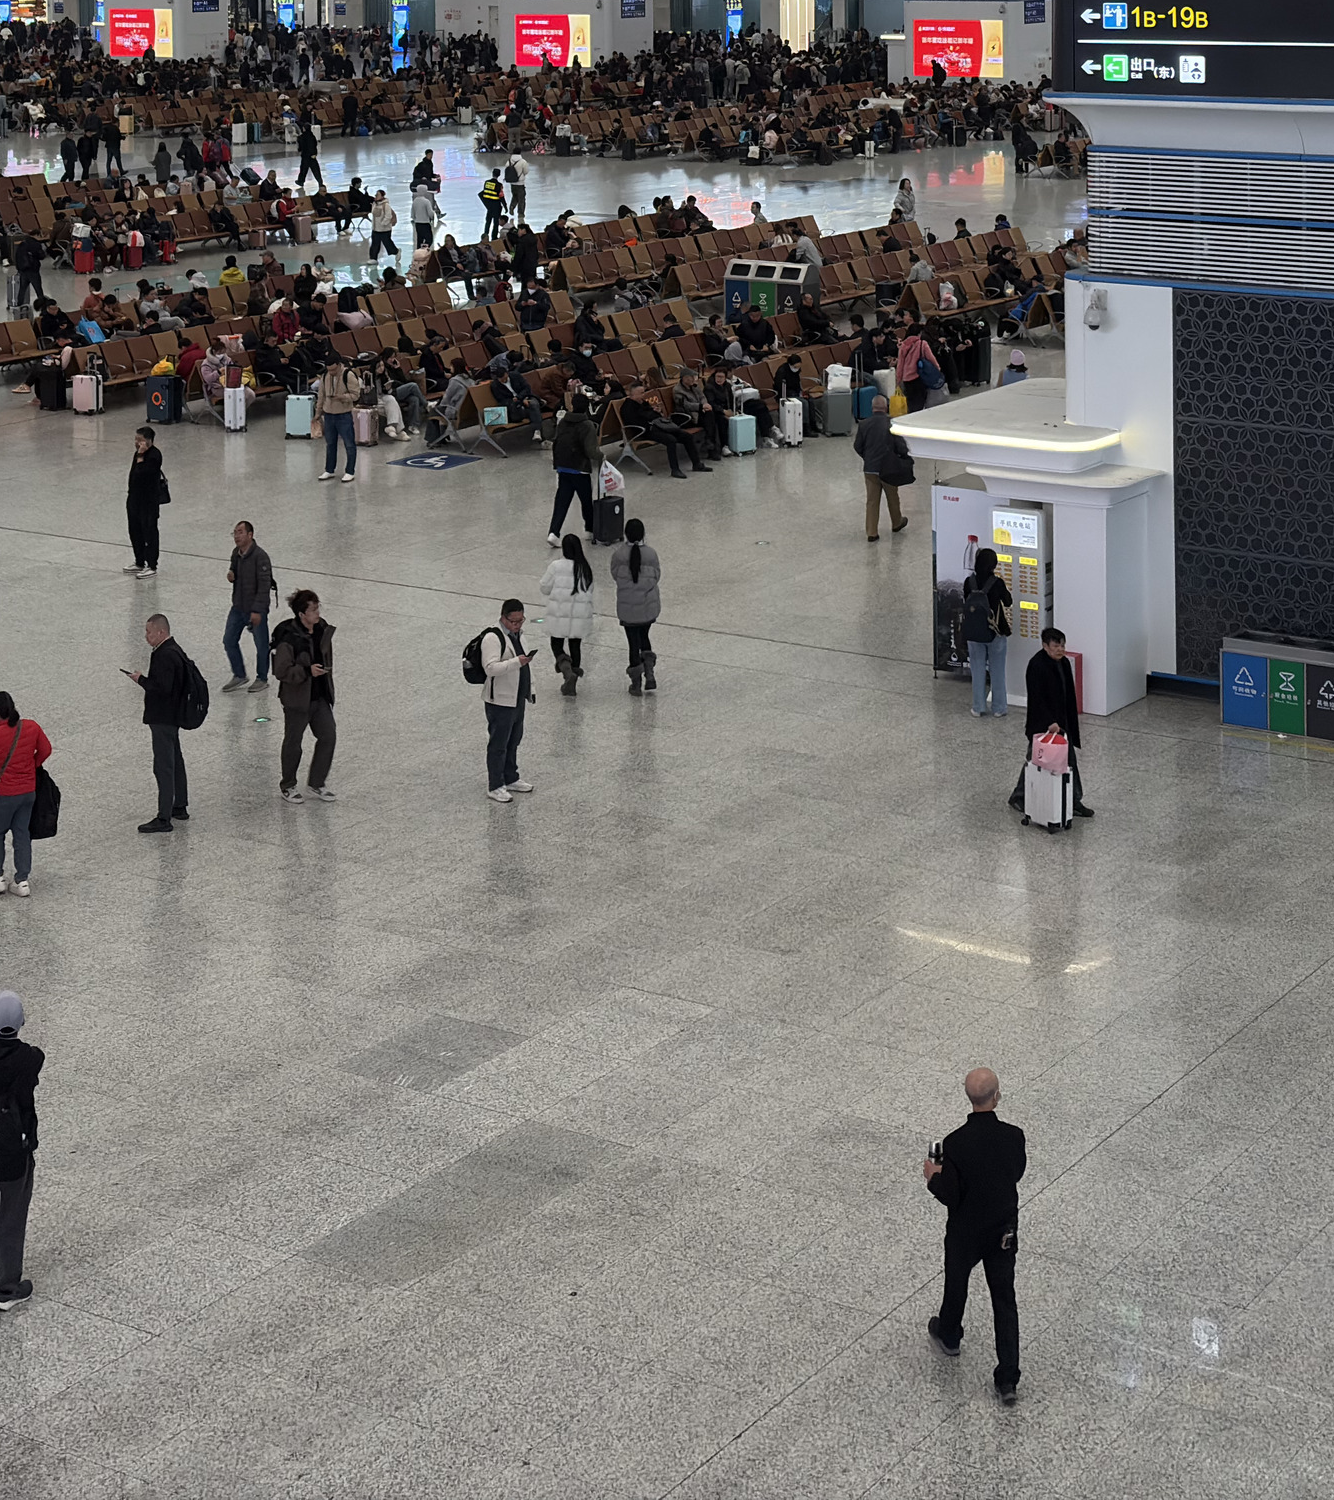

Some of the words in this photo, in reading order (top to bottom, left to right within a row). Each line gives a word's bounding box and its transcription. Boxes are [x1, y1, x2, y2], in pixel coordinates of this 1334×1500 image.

[1130, 6, 1209, 29] 1B-19B
[1130, 57, 1155, 72] 出口
[1153, 66, 1175, 80] (东)
[999, 519, 1031, 530] 手机充电站
[1232, 685, 1257, 695] 可回收物
